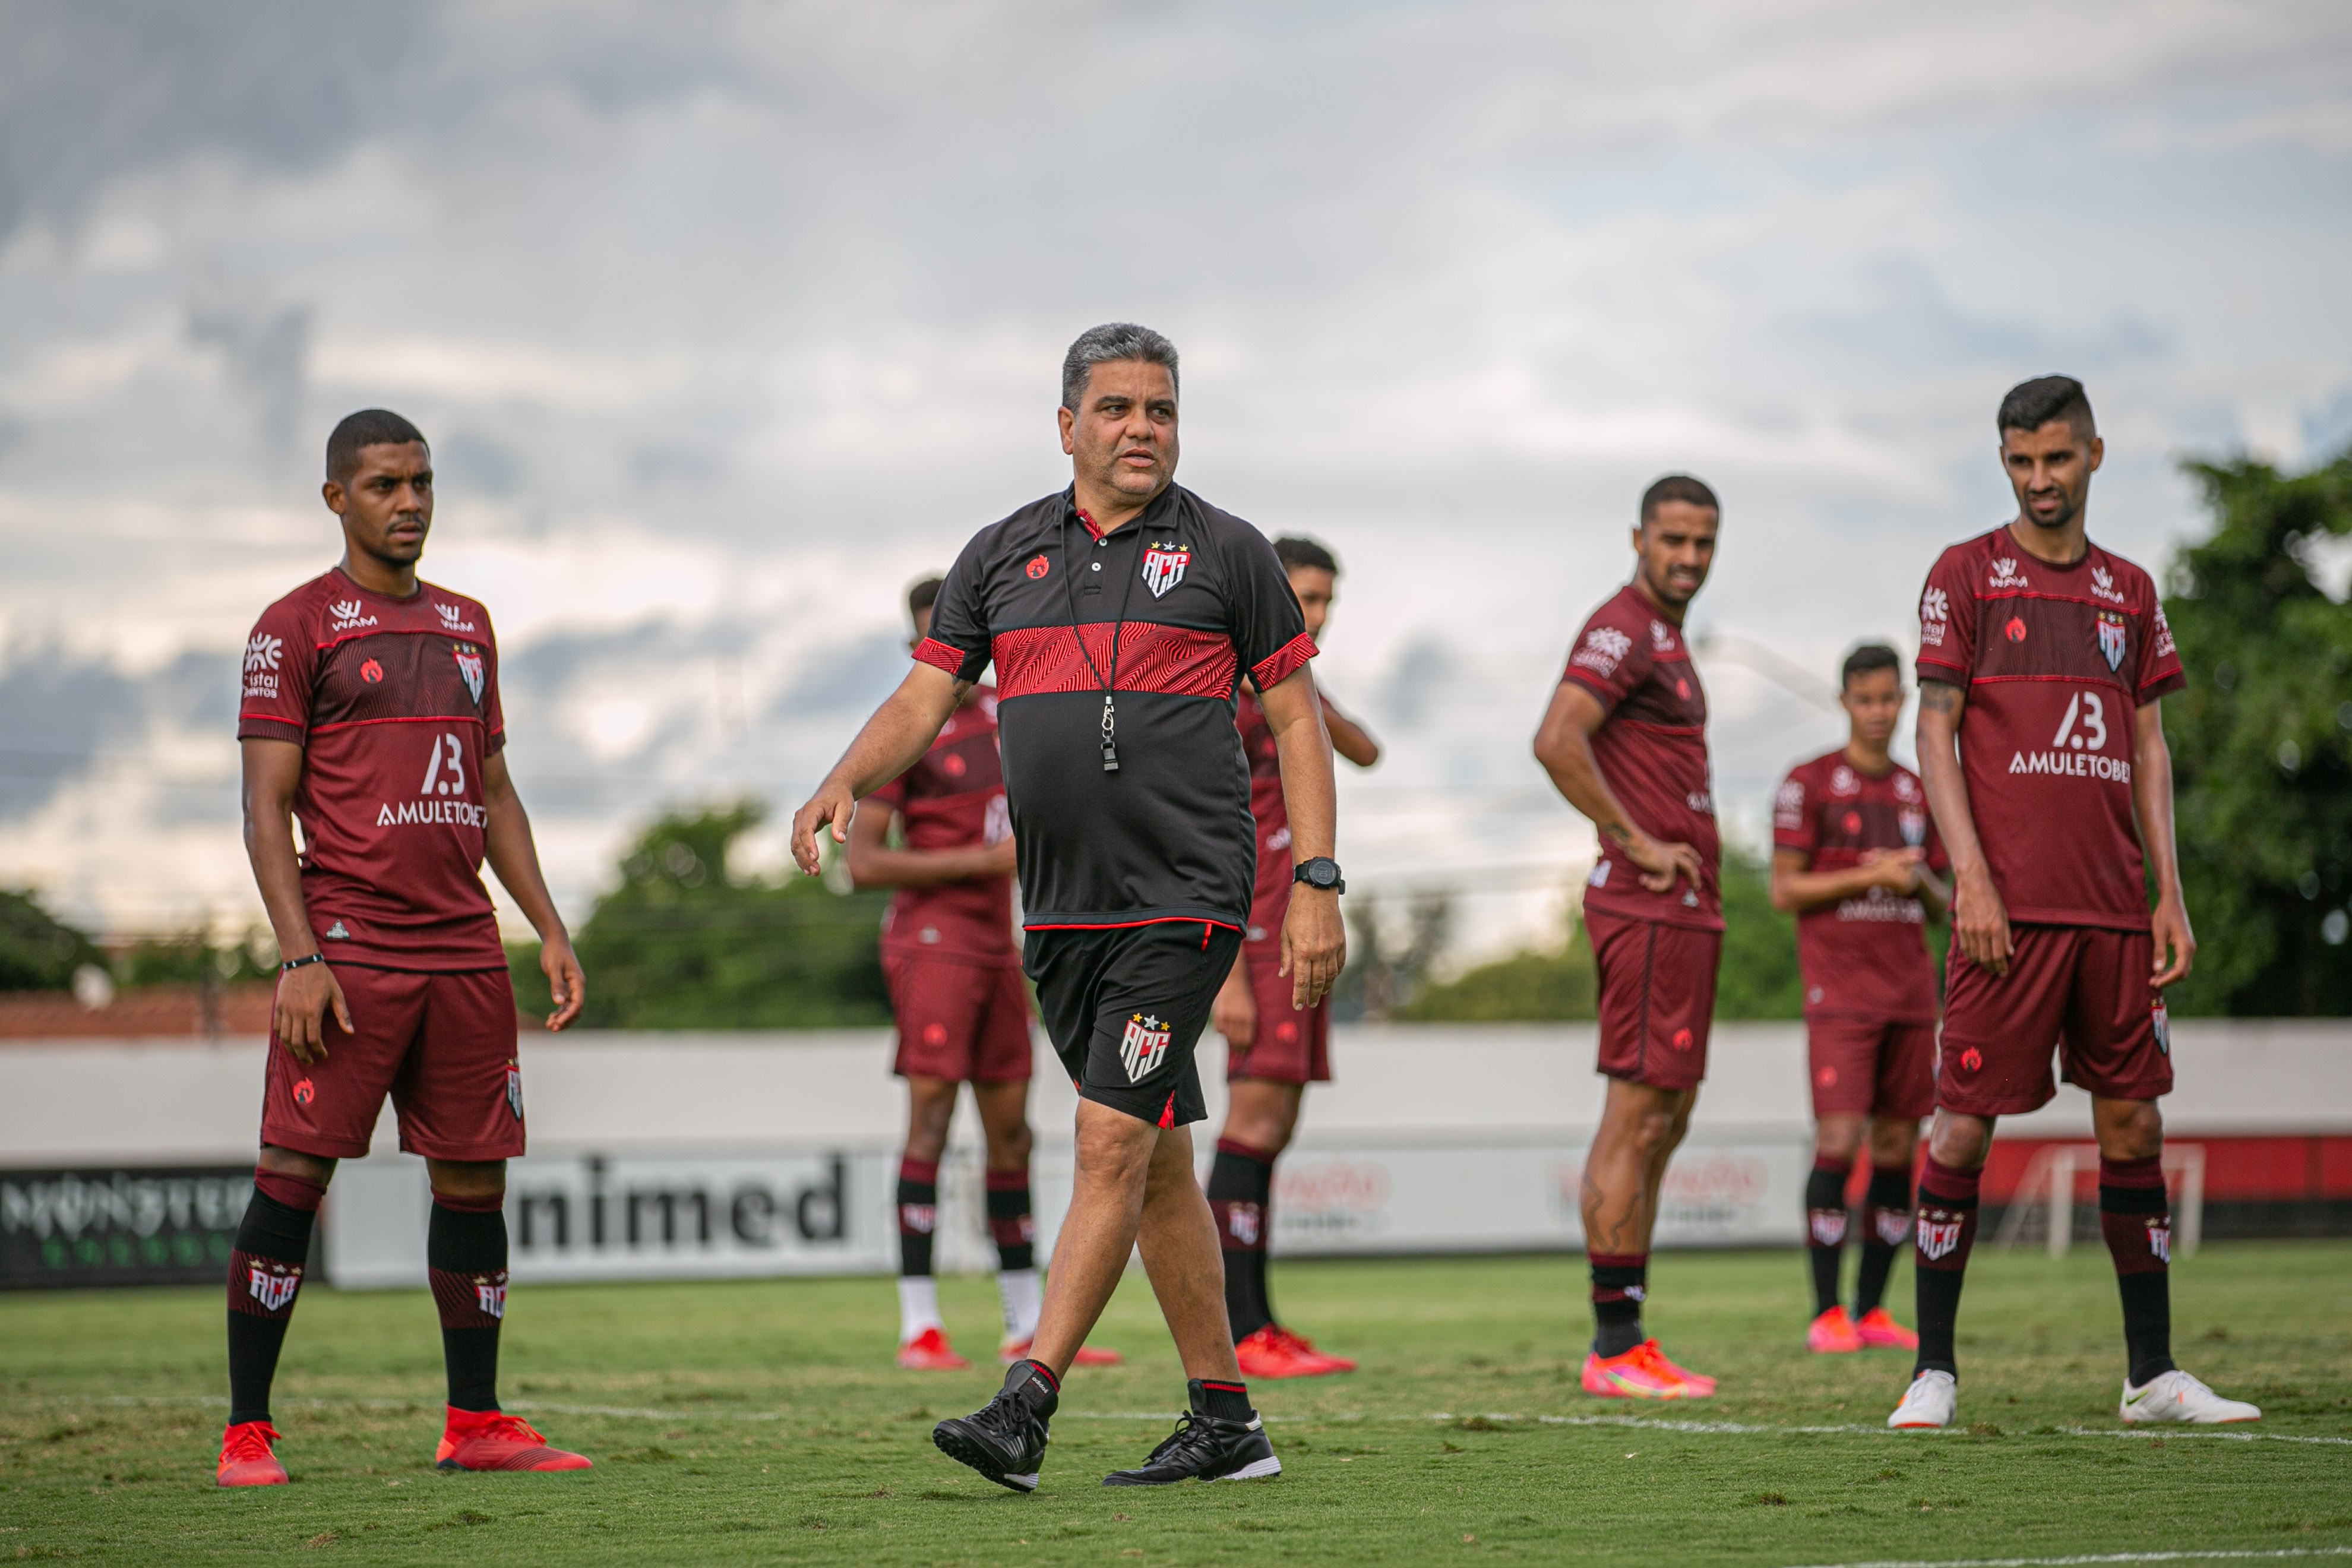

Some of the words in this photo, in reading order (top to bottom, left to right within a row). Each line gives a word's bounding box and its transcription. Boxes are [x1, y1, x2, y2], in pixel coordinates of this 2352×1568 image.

[1142, 551, 1188, 598] ACG
[332, 615, 378, 632] WAM
[2009, 750, 2130, 784] AMULETOBE
[1120, 1022, 1169, 1083] ACG
[517, 1151, 848, 1248] nimed
[478, 1285, 507, 1319] AC
[1032, 1377, 1049, 1393] adidas
